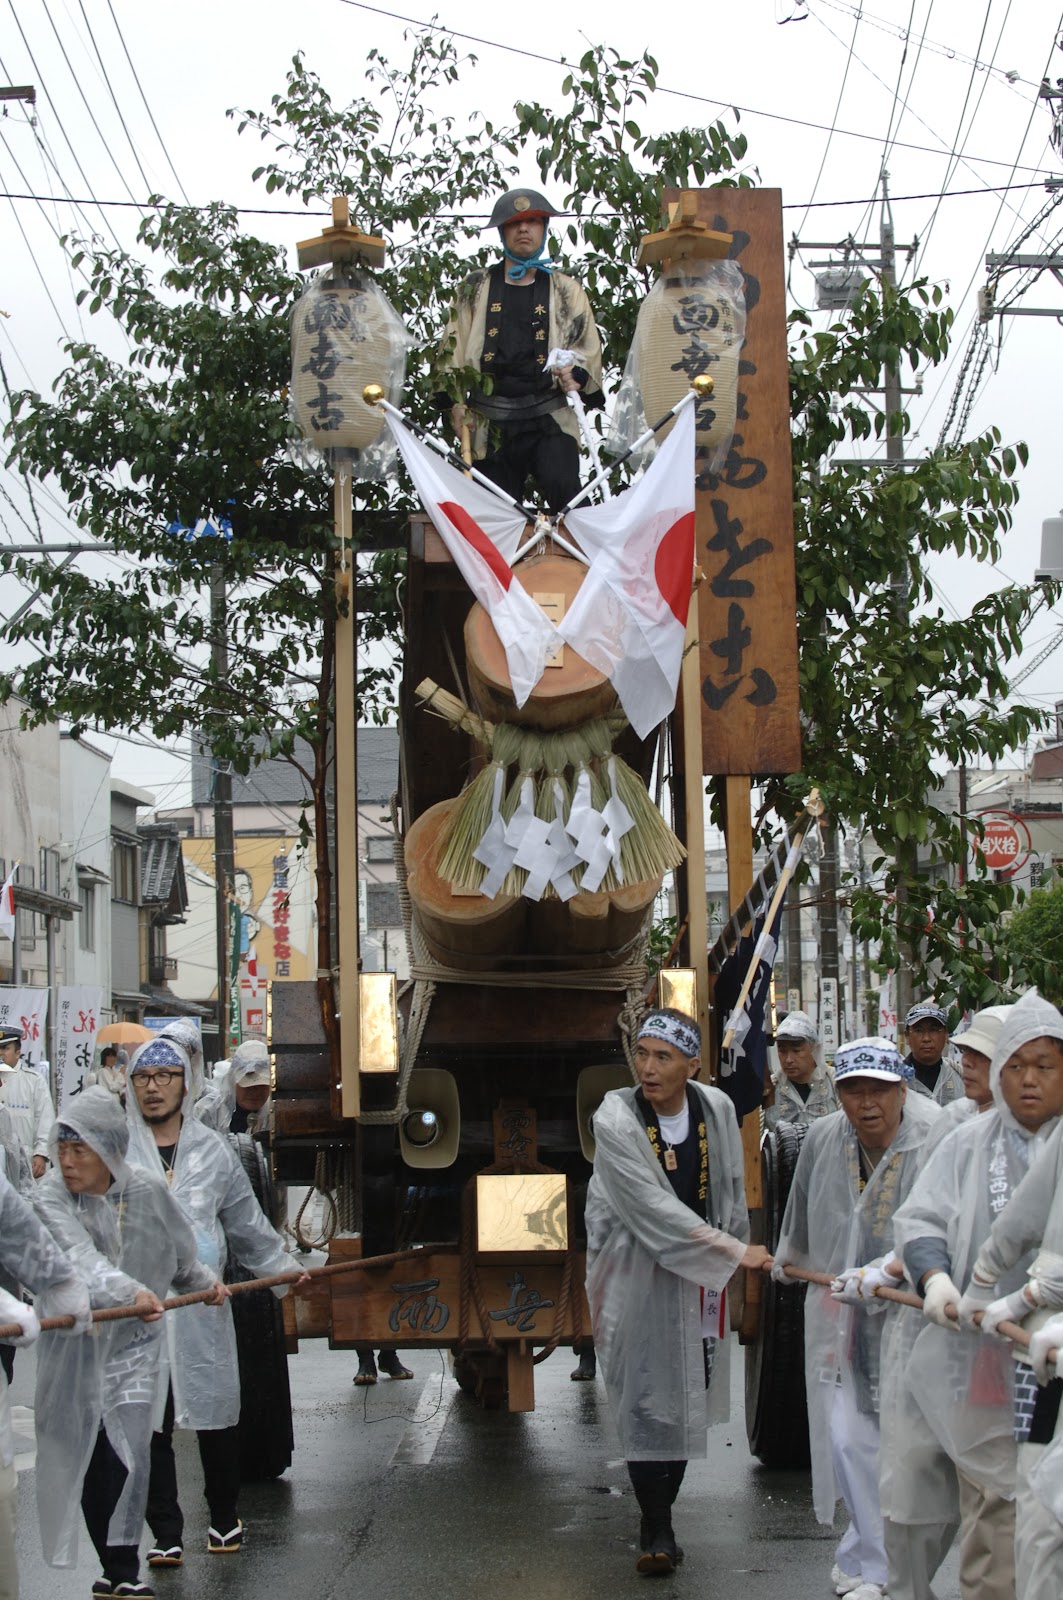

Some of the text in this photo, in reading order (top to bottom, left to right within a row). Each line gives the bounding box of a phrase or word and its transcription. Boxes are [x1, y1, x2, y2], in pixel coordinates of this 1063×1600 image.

[976, 836, 1017, 855] 消火栓
[272, 855, 291, 977] 修理大好きな店
